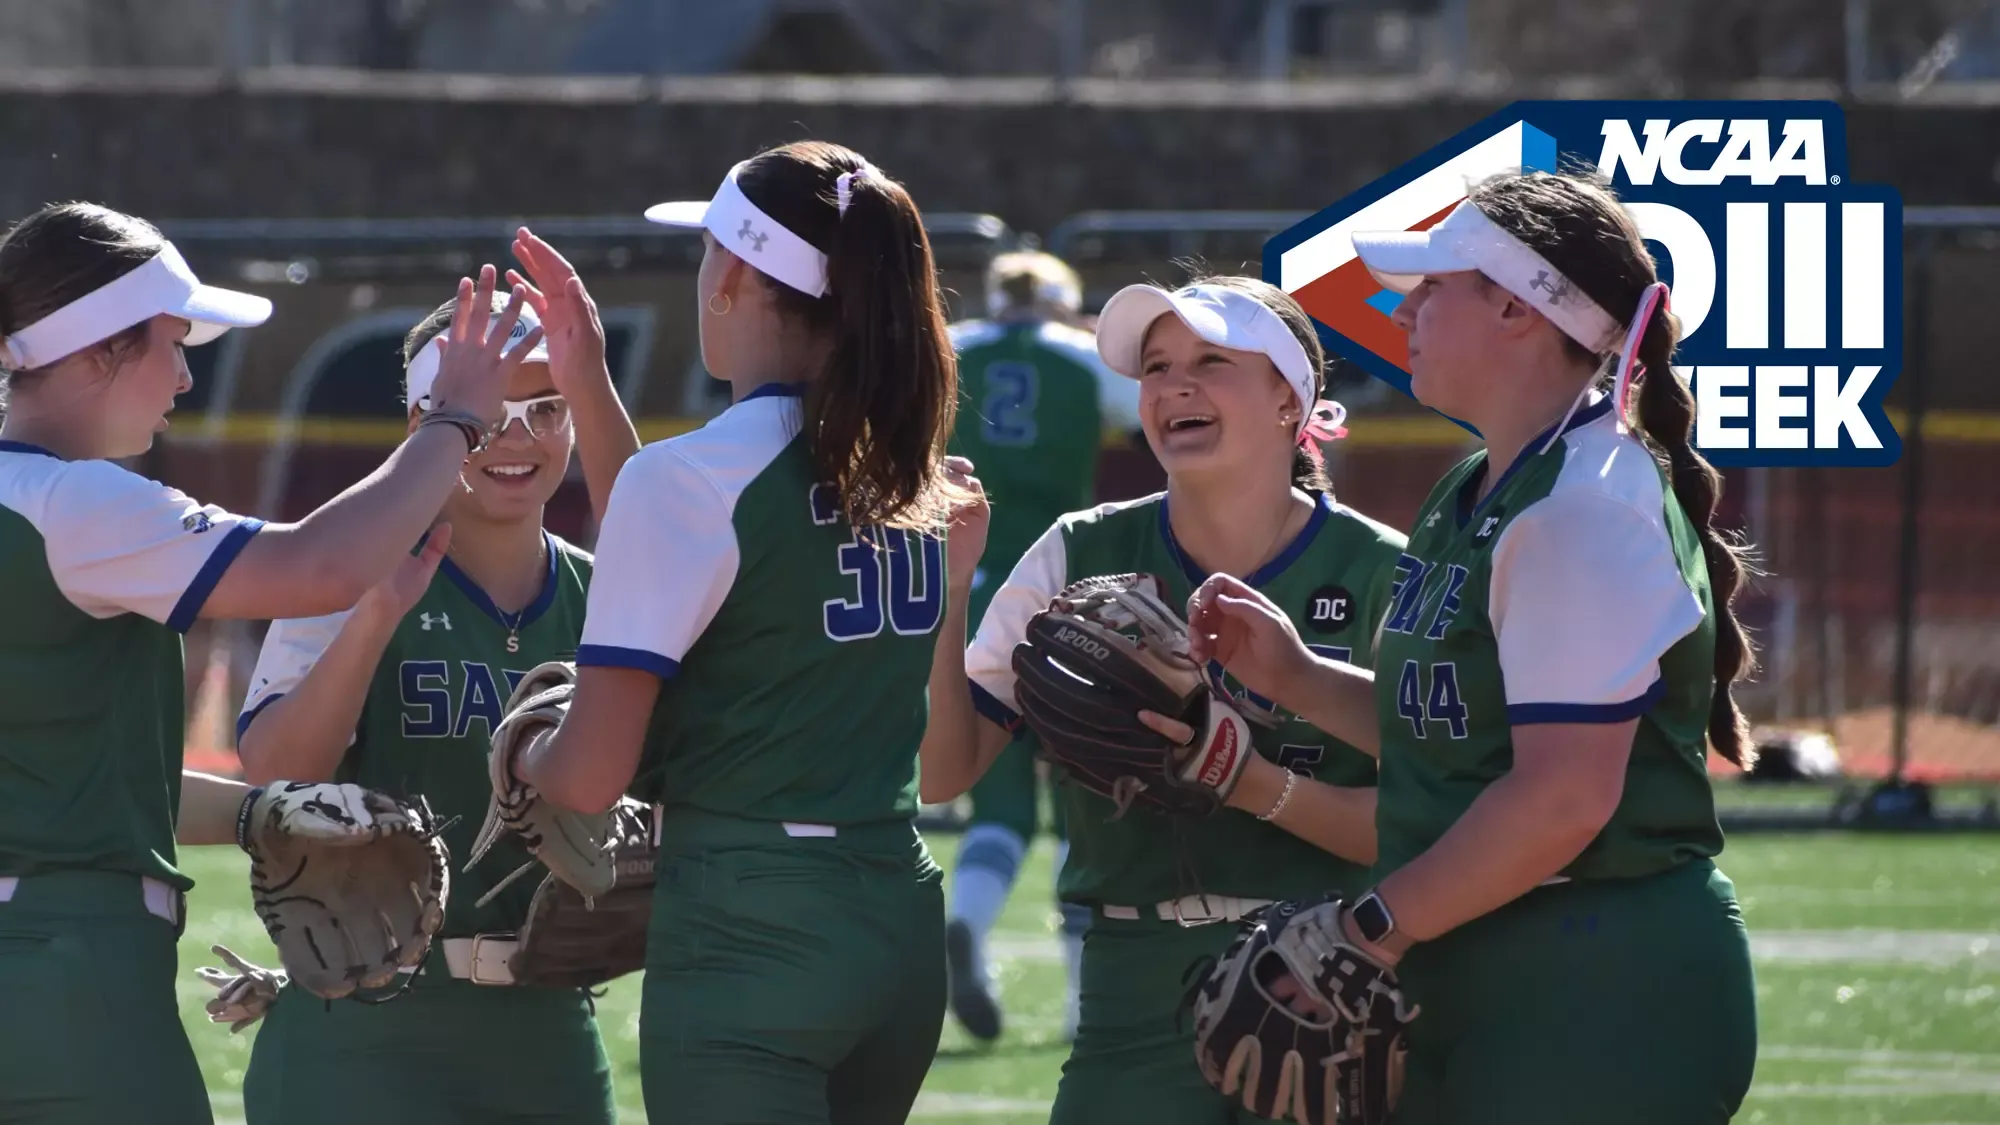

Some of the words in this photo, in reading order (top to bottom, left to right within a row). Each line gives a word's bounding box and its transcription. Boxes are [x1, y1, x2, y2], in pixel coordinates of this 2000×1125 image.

[981, 361, 1038, 447] 2
[810, 481, 944, 642] 30
[1312, 598, 1347, 621] DC
[506, 636, 520, 652] S
[1053, 626, 1111, 660] A2000
[1398, 659, 1469, 739] 44
[1202, 727, 1236, 787] Wilson
